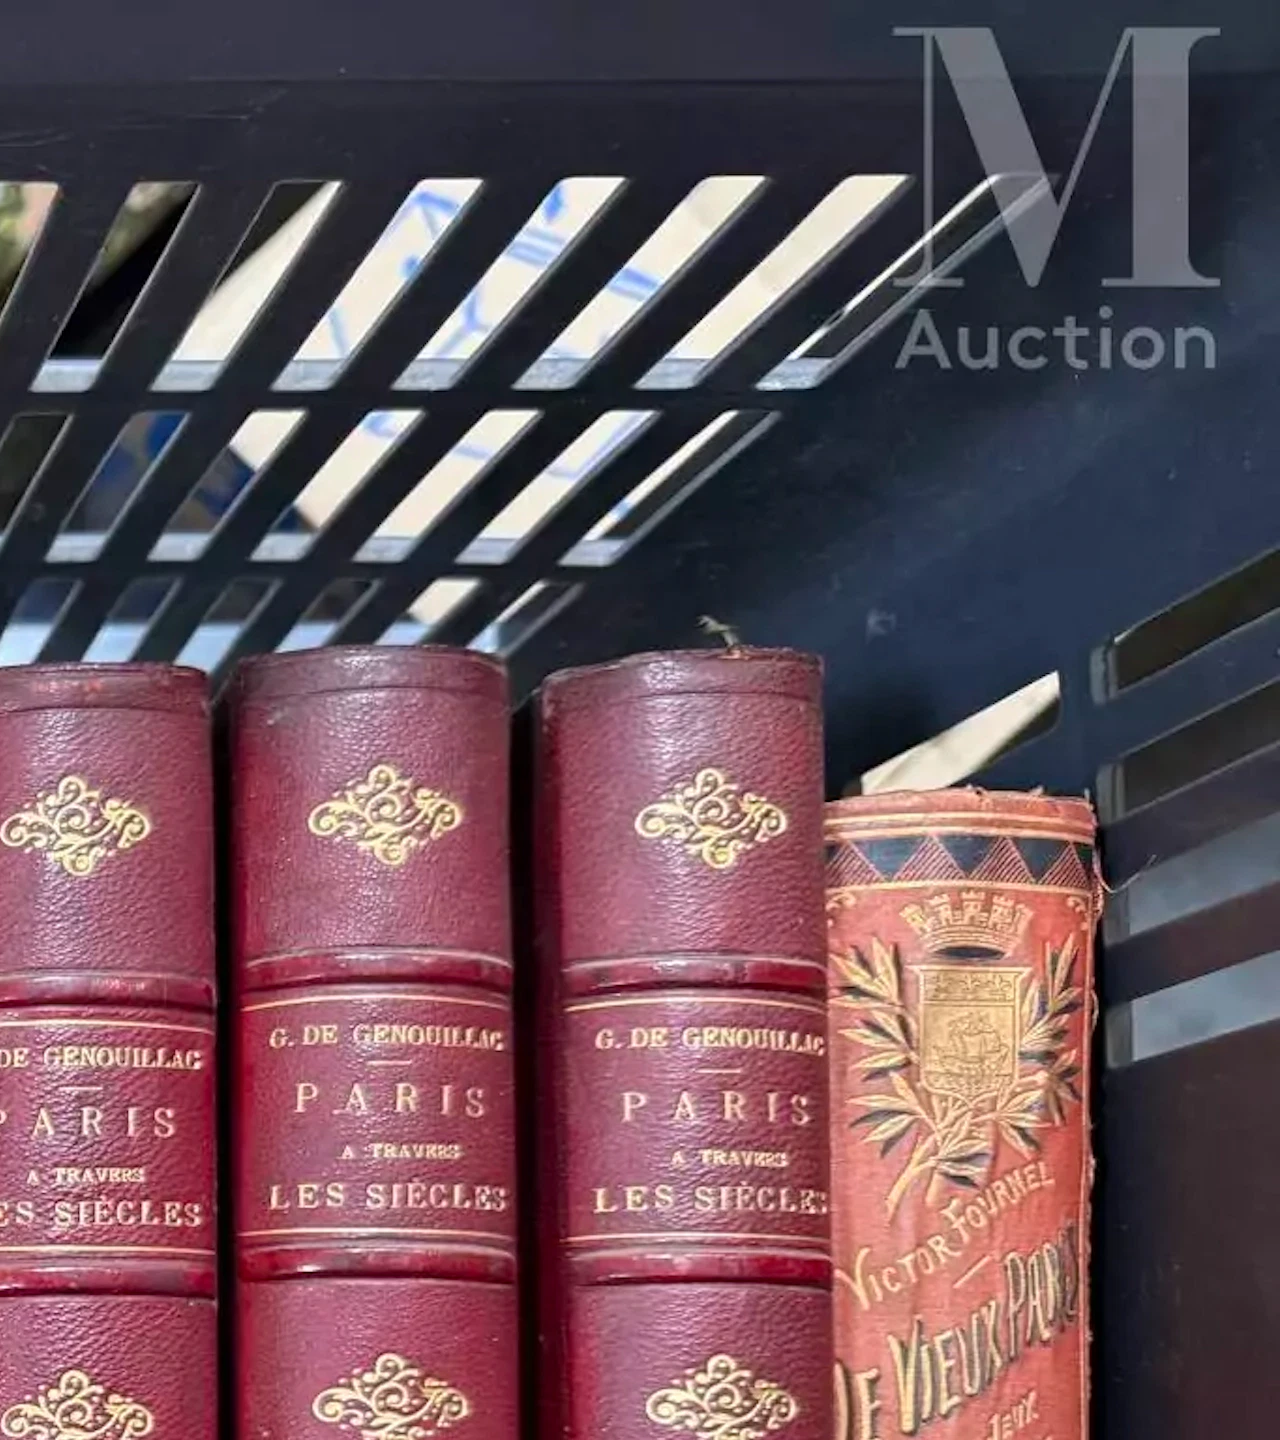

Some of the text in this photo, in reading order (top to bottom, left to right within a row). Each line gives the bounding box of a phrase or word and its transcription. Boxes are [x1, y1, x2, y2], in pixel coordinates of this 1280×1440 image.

[269, 1024, 505, 1051] G. DE GENOUILLAC
[594, 1029, 623, 1049] G.
[629, 1027, 669, 1049] DE
[43, 1046, 202, 1070] GENOUILLAC
[294, 1082, 485, 1118] PARIS
[621, 1090, 811, 1125] PARIS
[370, 1143, 462, 1160] TRAVERS
[699, 1149, 788, 1168] TRAVERS
[54, 1167, 145, 1183] TRAVERS
[269, 1177, 507, 1211] LES SIÈCLES
[593, 1184, 674, 1214] LES
[55, 1195, 202, 1228] SIÈCLES
[835, 1161, 1056, 1311] VICTOR FOURNEL
[888, 1299, 1006, 1436] VIEUX
